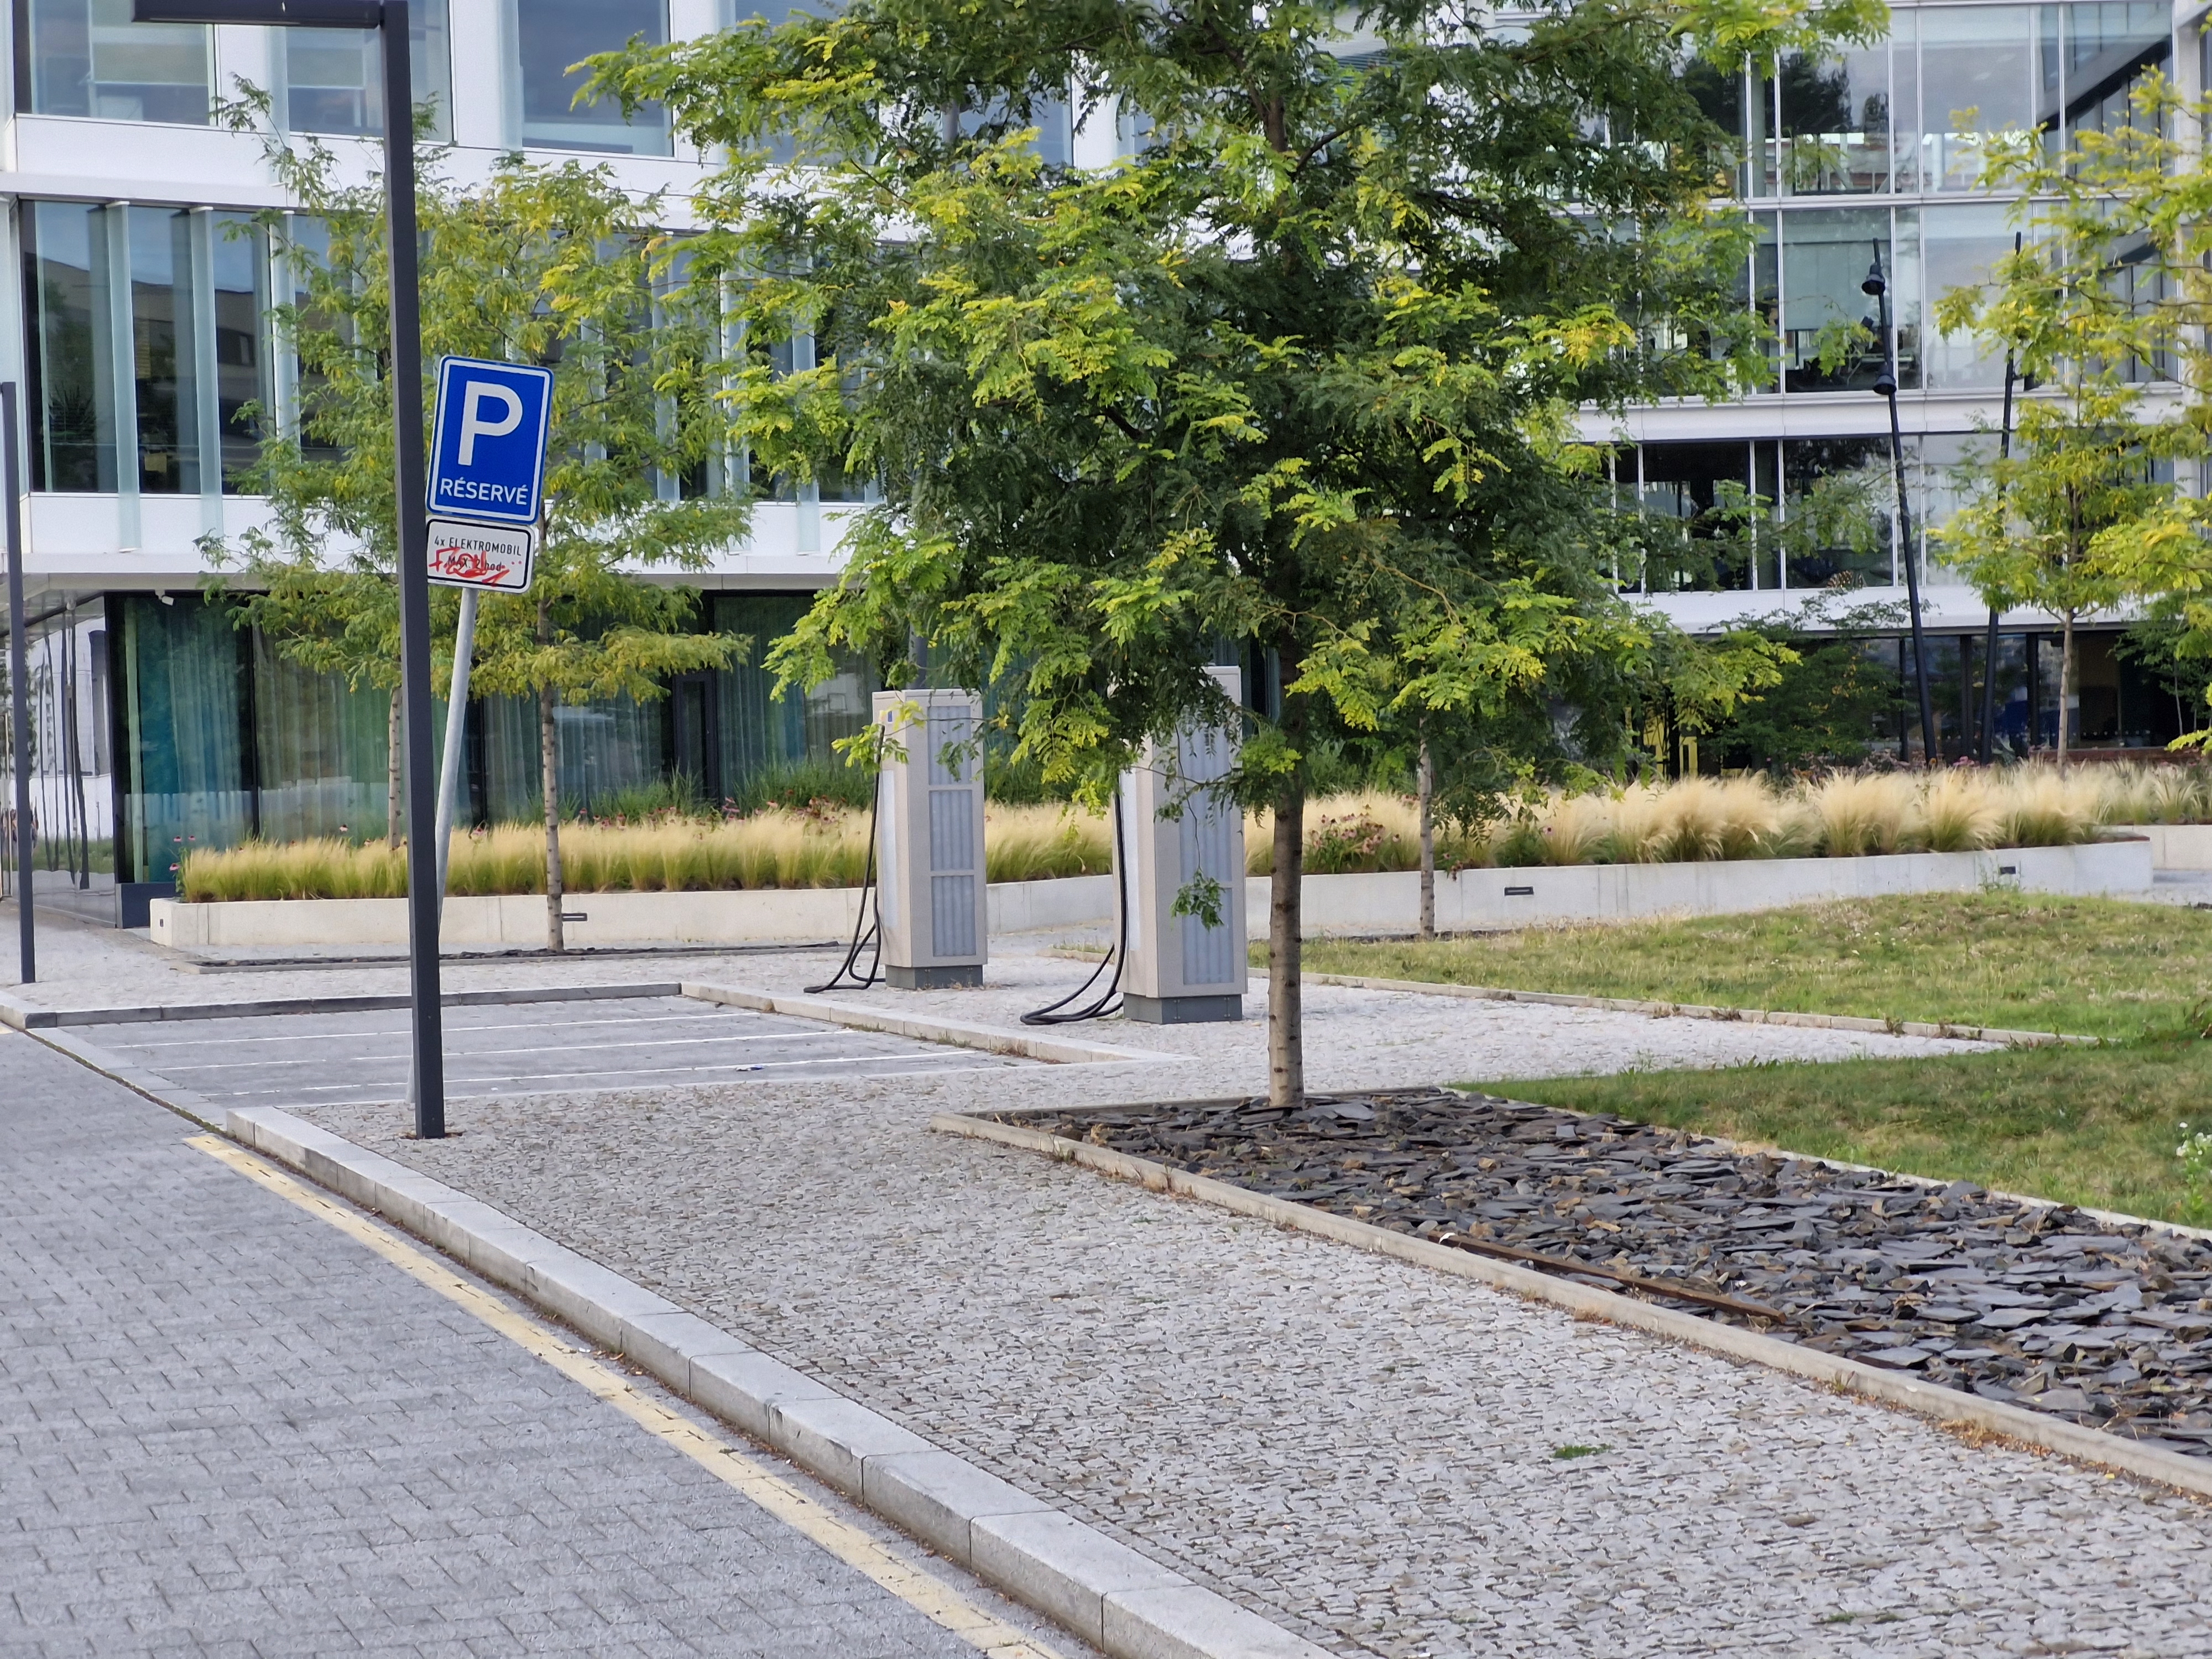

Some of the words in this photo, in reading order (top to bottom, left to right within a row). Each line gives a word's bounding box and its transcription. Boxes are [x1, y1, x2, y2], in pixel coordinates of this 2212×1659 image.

[458, 380, 523, 466] P
[440, 477, 528, 505] RÉSERVÉ
[434, 535, 445, 547] 4x
[448, 537, 521, 556] ELEKTROMOBIL
